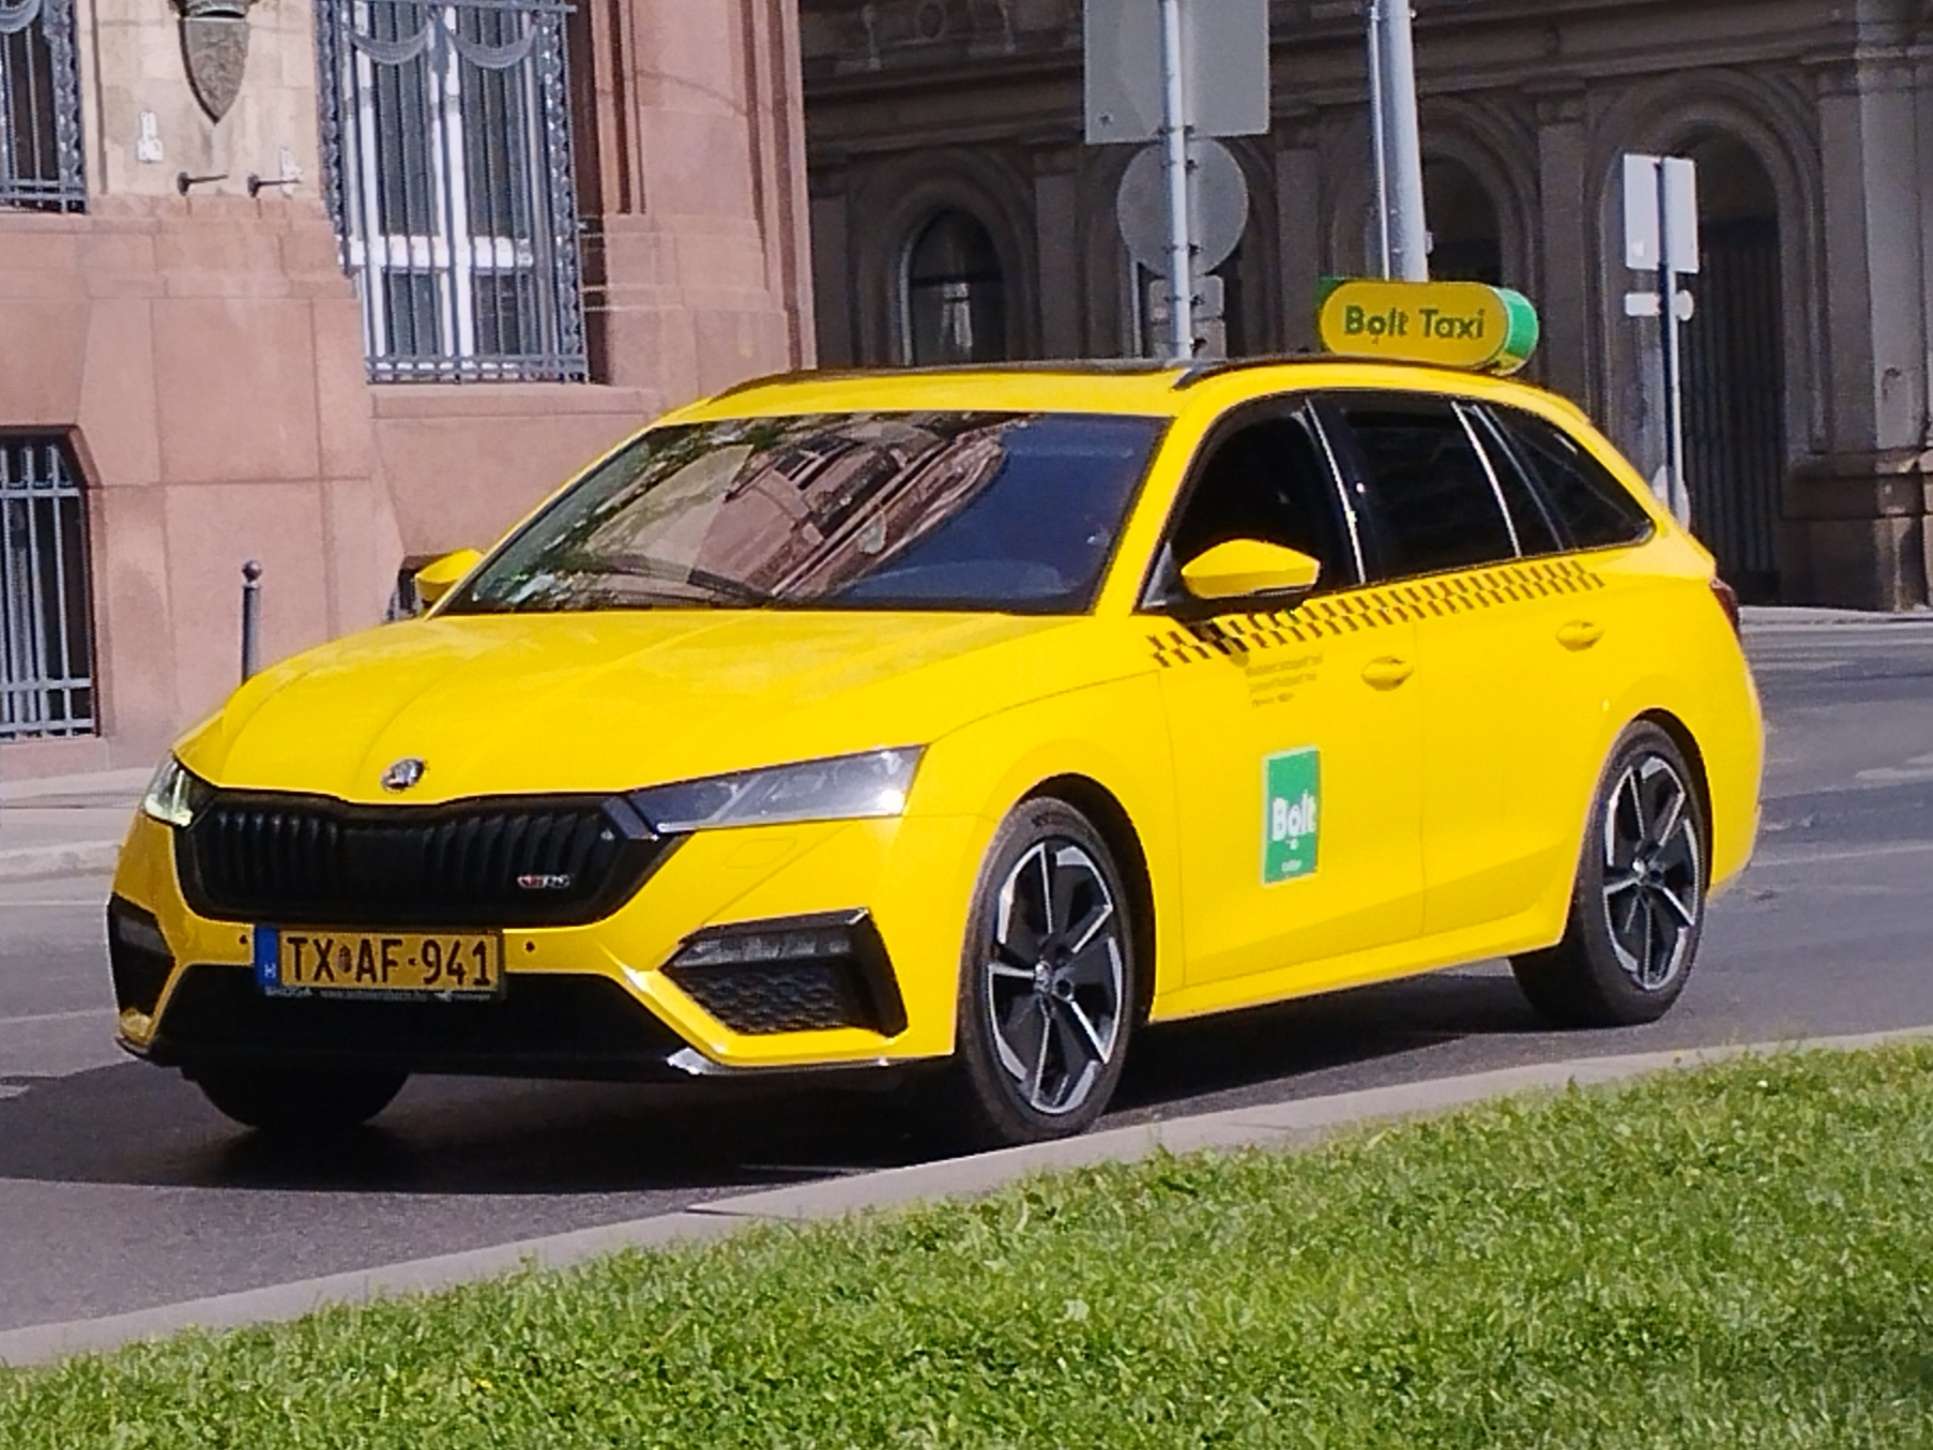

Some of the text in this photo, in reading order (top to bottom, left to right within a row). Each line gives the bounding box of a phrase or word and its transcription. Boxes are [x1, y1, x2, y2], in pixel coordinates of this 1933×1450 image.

[1344, 305, 1485, 343] Bolt Taxi
[1272, 788, 1316, 849] Bolt
